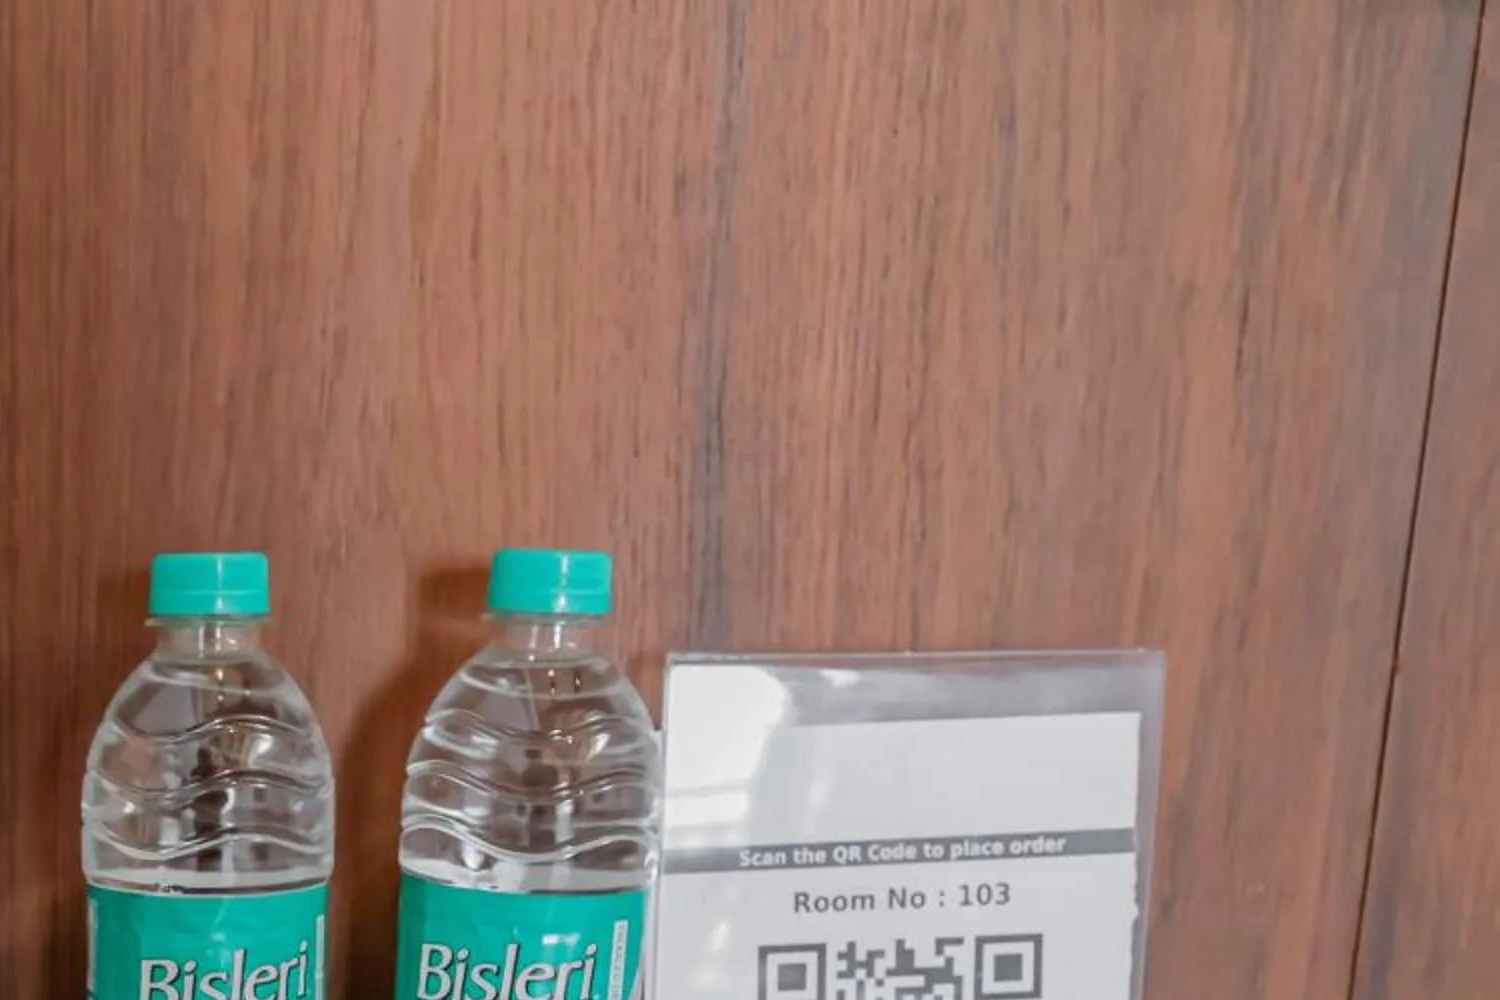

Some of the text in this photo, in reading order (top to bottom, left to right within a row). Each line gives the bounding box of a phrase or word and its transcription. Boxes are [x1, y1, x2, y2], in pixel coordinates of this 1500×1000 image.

[739, 836, 1067, 867] Scan the QR Code to place order
[795, 891, 876, 914] Room
[888, 887, 927, 910] No
[958, 881, 1011, 906] 103
